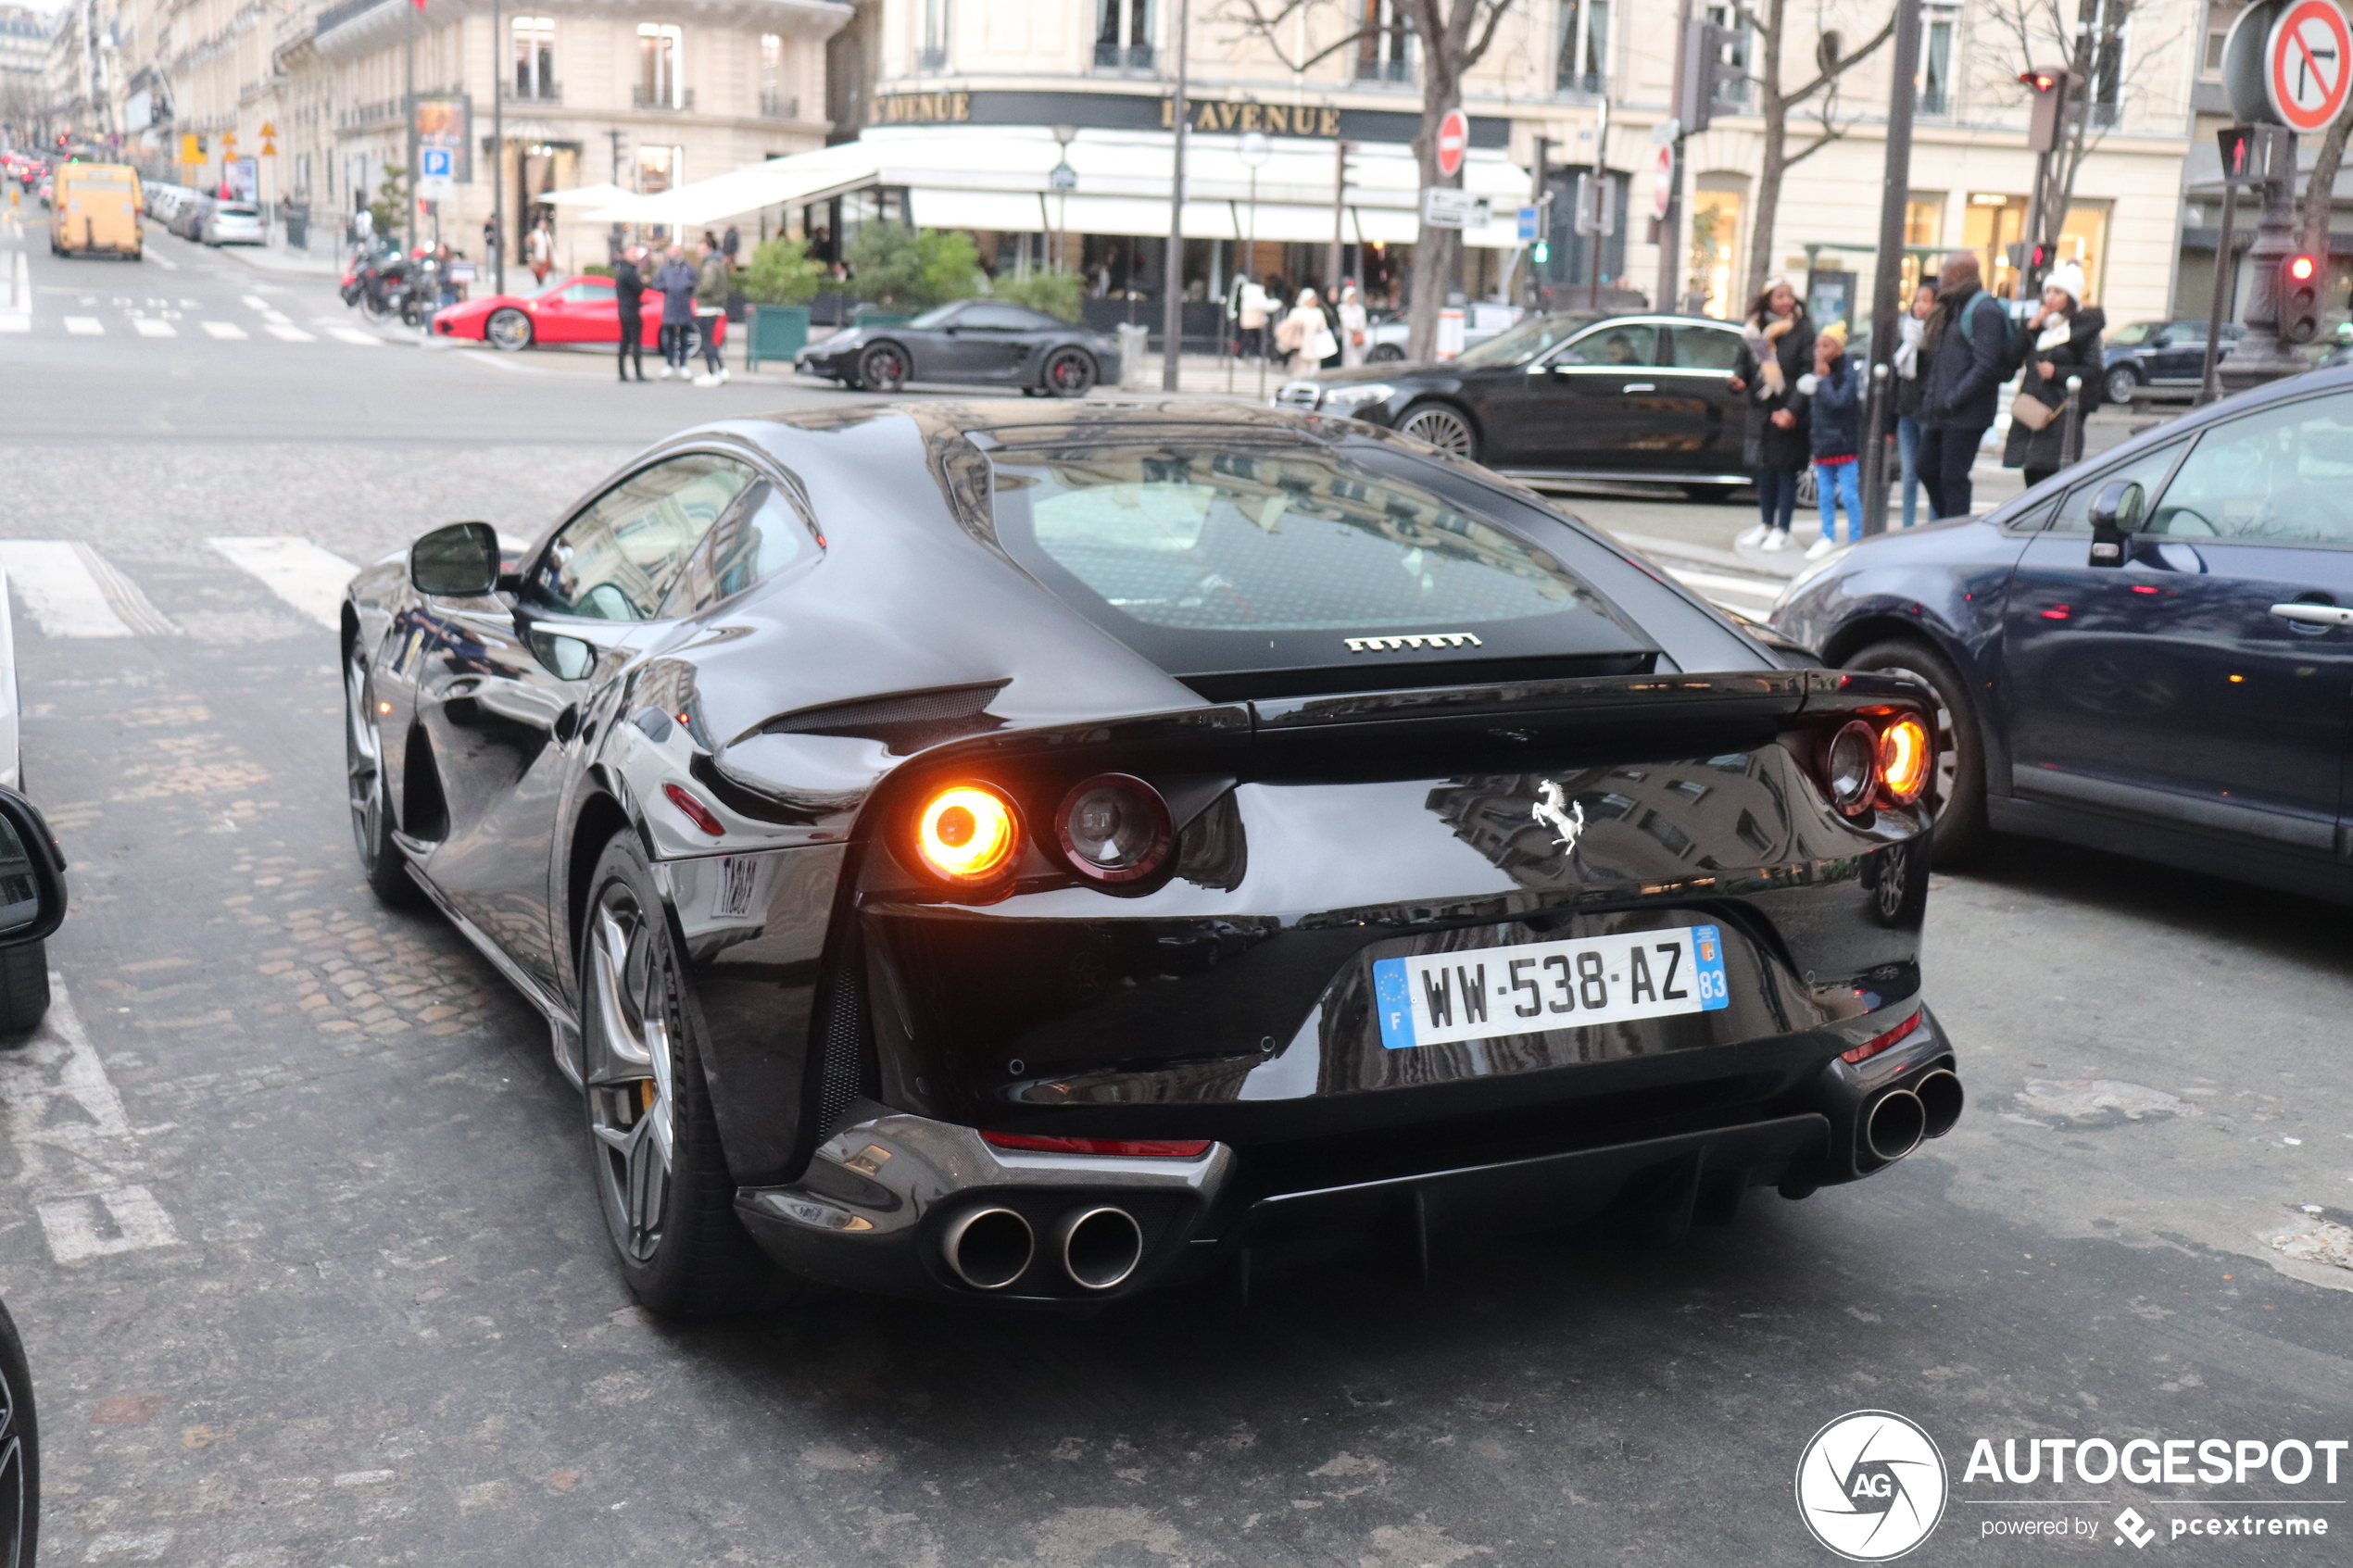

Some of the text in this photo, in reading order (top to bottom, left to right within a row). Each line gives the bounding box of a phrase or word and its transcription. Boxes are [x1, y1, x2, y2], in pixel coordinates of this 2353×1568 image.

[429, 153, 446, 173] P
[1699, 970, 1727, 999] 83
[1390, 1011, 1402, 1031] F
